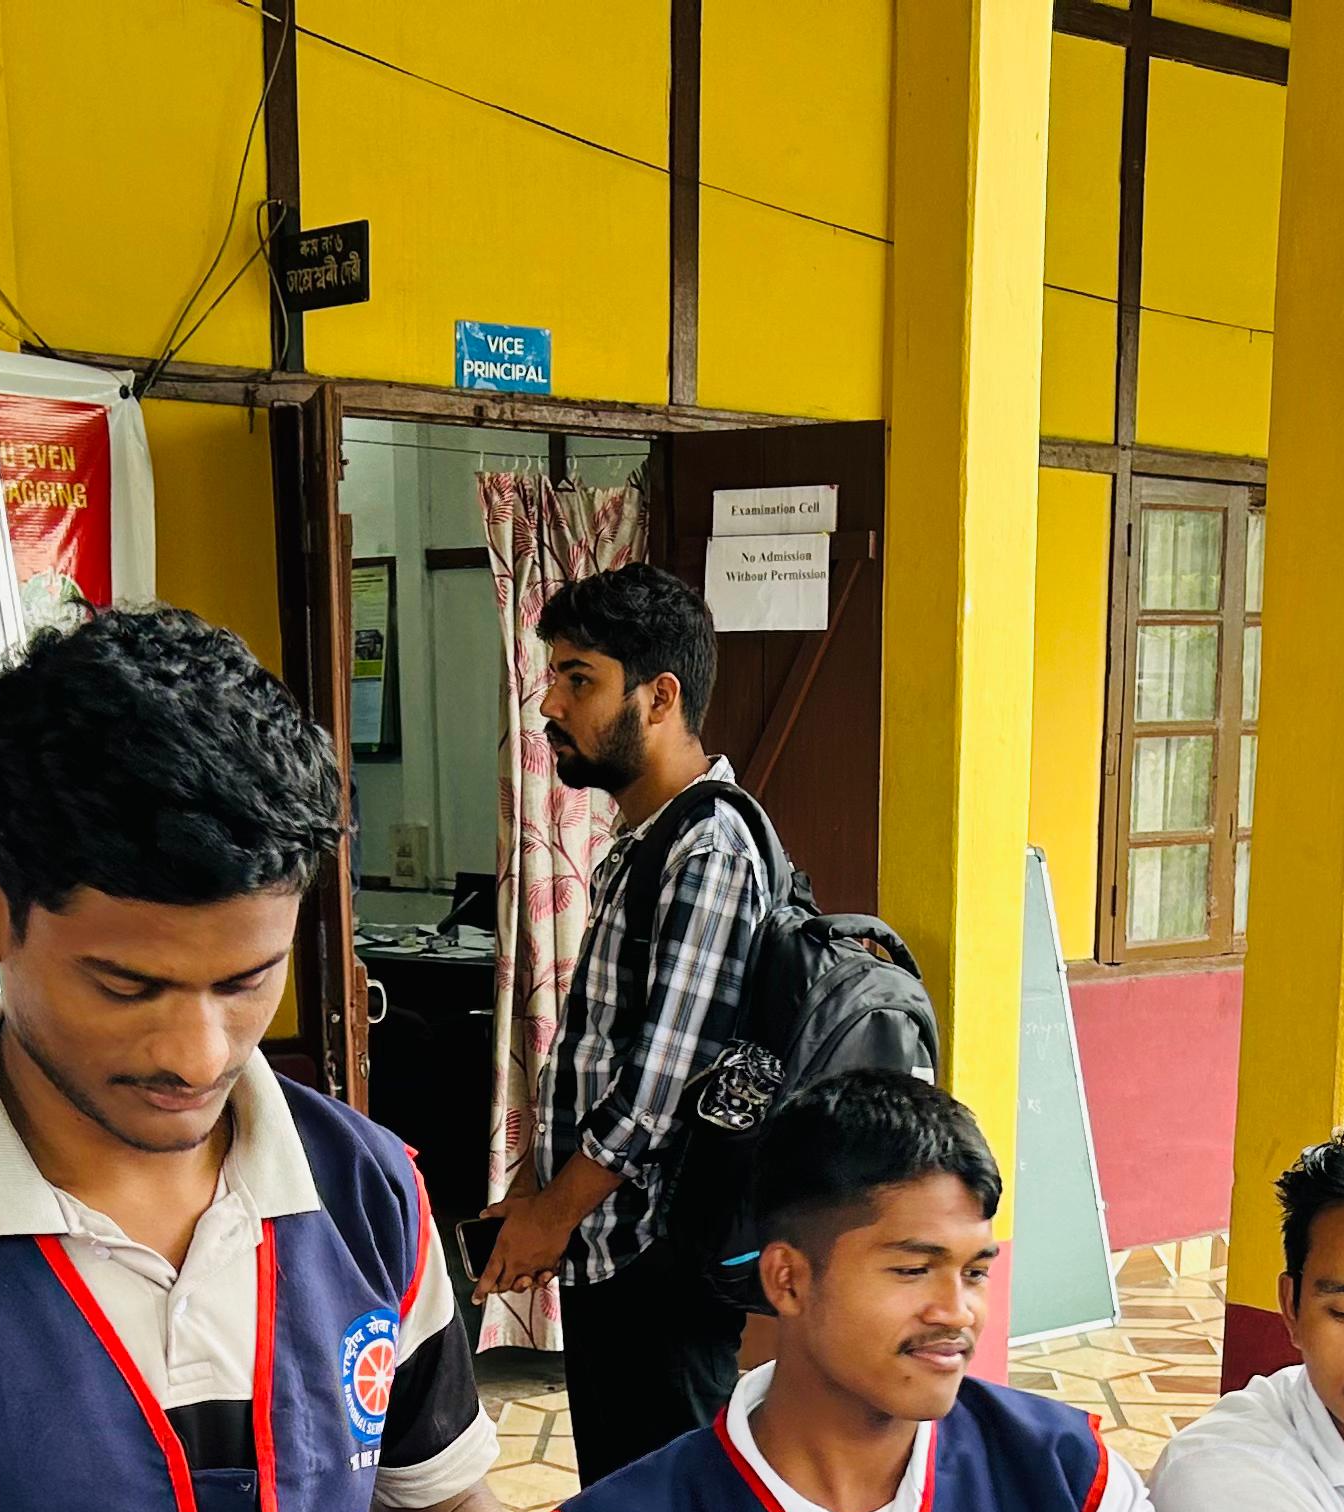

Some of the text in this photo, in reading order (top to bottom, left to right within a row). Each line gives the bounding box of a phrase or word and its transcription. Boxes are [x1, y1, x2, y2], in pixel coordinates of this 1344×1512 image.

[487, 335, 525, 356] VICE
[462, 359, 548, 384] PRINCIPAL
[24, 444, 76, 471] EVEN
[4, 478, 88, 509] AGGING
[731, 501, 821, 518] Examination Cell
[741, 550, 812, 563] No Admission
[725, 567, 828, 582] Without Permission
